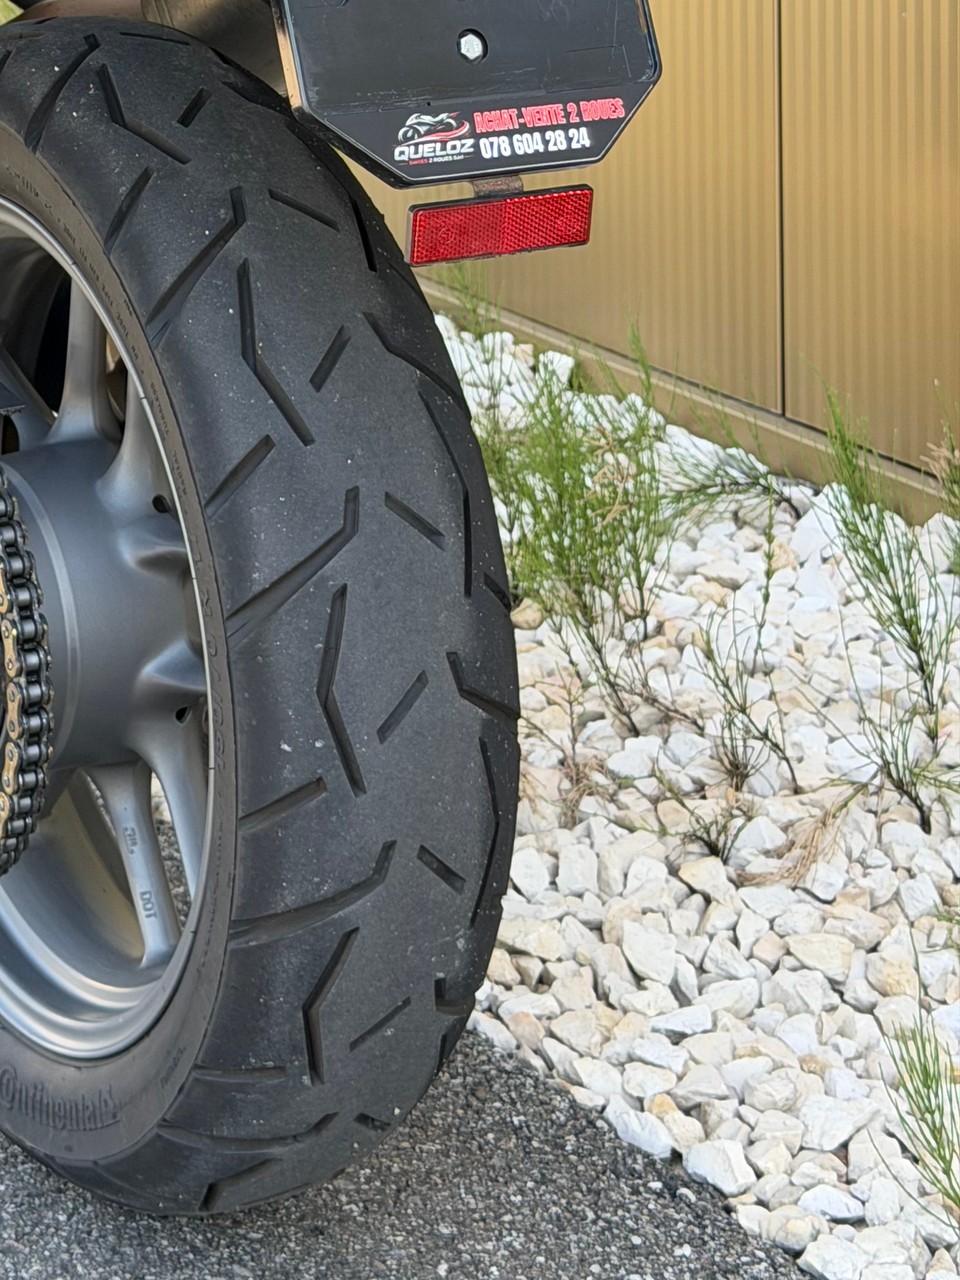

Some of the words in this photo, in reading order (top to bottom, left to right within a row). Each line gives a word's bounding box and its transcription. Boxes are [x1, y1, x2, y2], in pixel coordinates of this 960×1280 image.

[473, 103, 567, 134] ACHAT-VENTE
[566, 102, 580, 123] 2
[579, 98, 626, 122] ROUES
[393, 138, 475, 161] QUELOZ
[479, 136, 512, 159] 078
[512, 131, 545, 155] 604
[545, 129, 568, 152] 28
[568, 126, 591, 150] 24
[139, 889, 158, 919] DOT
